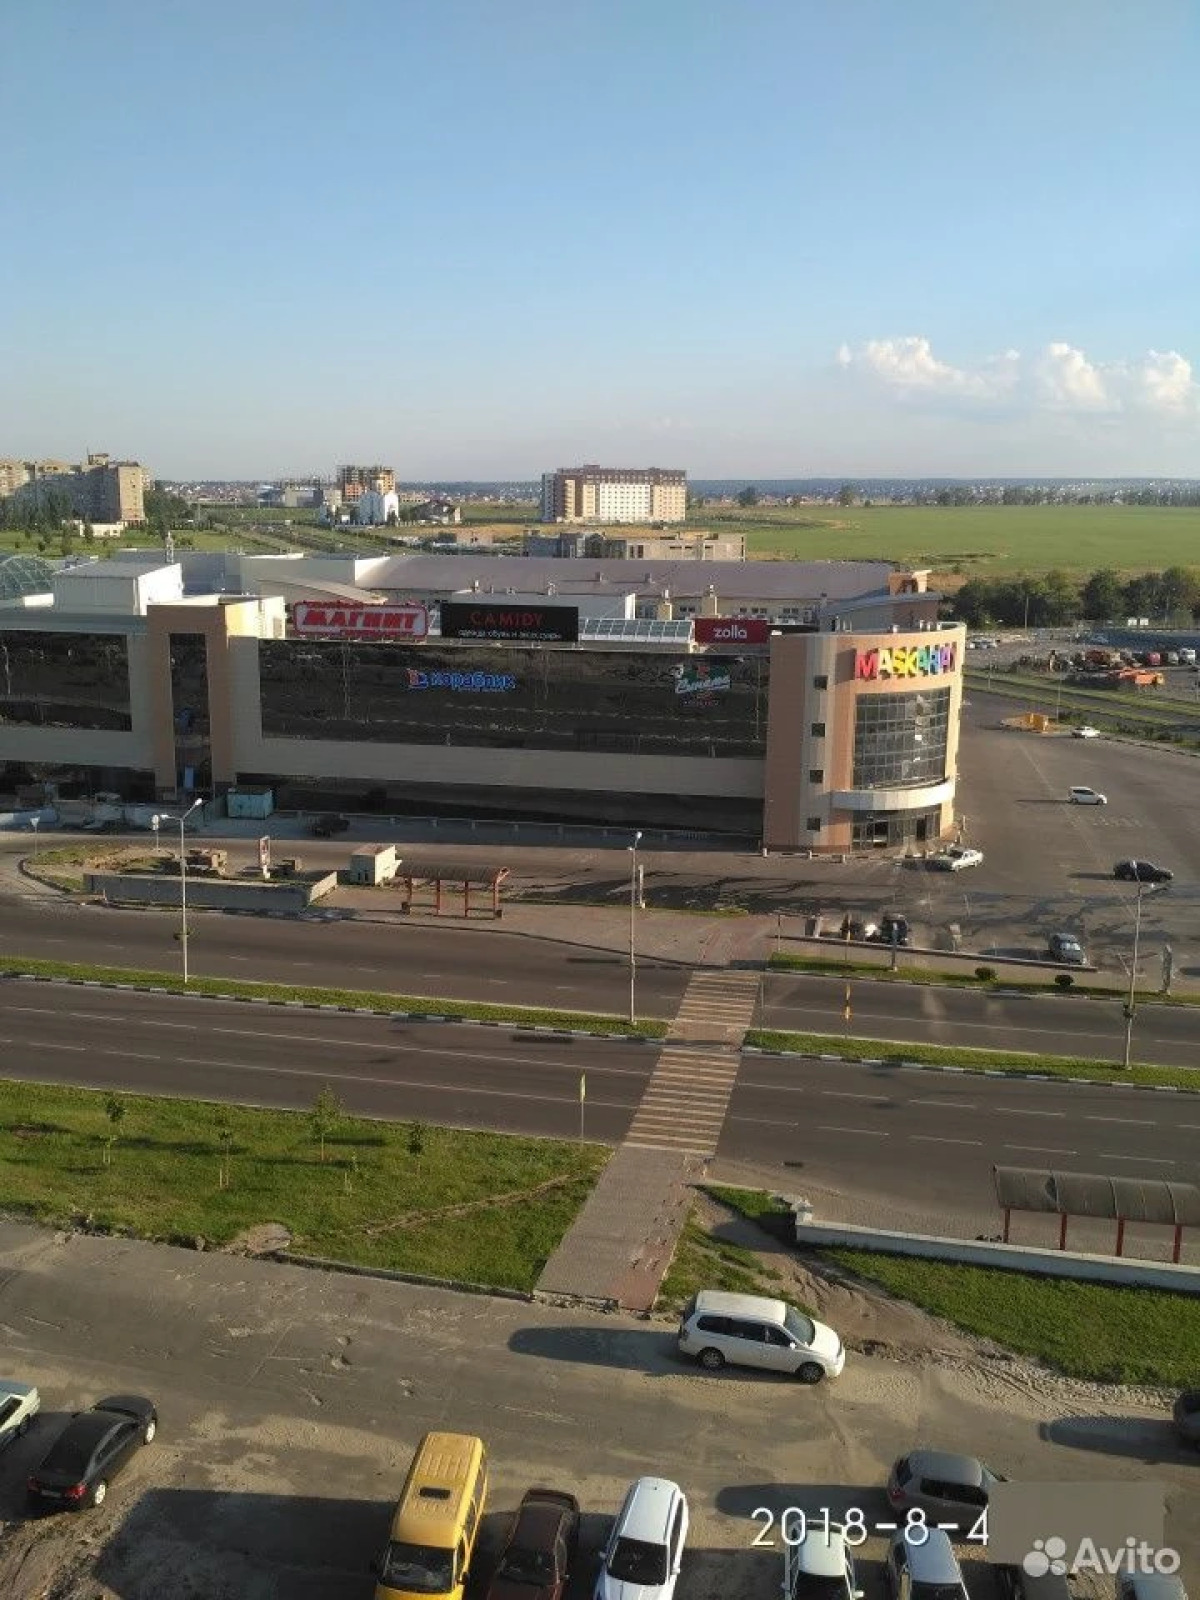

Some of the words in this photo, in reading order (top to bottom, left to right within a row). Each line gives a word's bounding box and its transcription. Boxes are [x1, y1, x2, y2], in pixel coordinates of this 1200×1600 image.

[302, 609, 420, 629] МАГНИТ
[469, 611, 543, 627] CAMIDY
[713, 624, 748, 639] zolla
